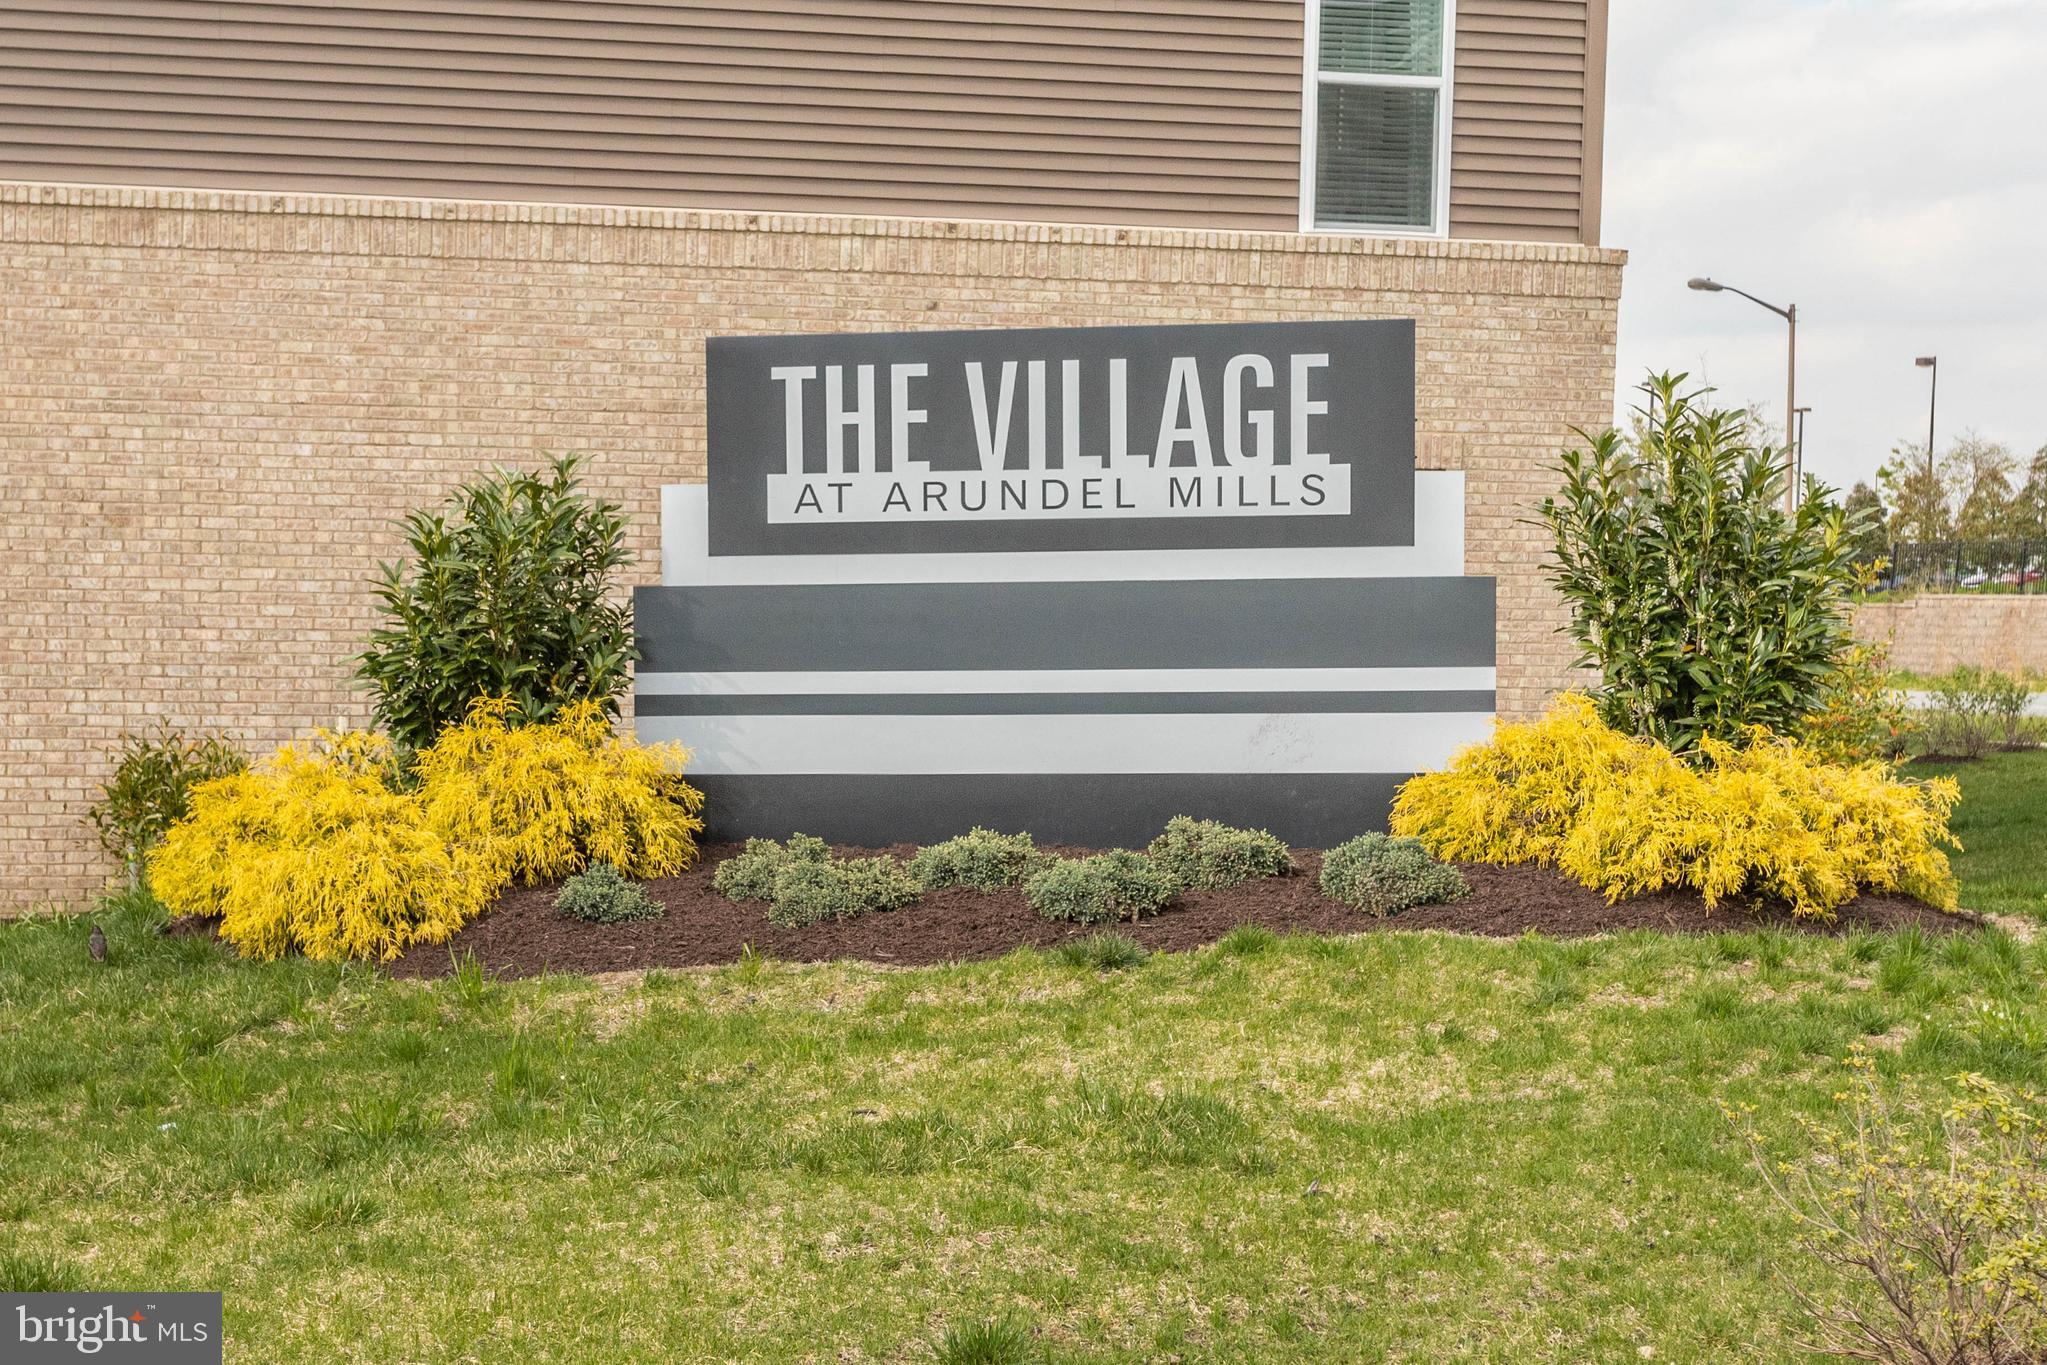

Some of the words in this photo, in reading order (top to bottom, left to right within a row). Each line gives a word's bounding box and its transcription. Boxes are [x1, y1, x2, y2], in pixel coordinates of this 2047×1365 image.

[770, 363, 931, 475] THE
[964, 353, 1331, 473] VILLAGE
[794, 482, 854, 515] AT
[882, 477, 1137, 514] ARUNDEL
[1169, 473, 1327, 509] MILLS
